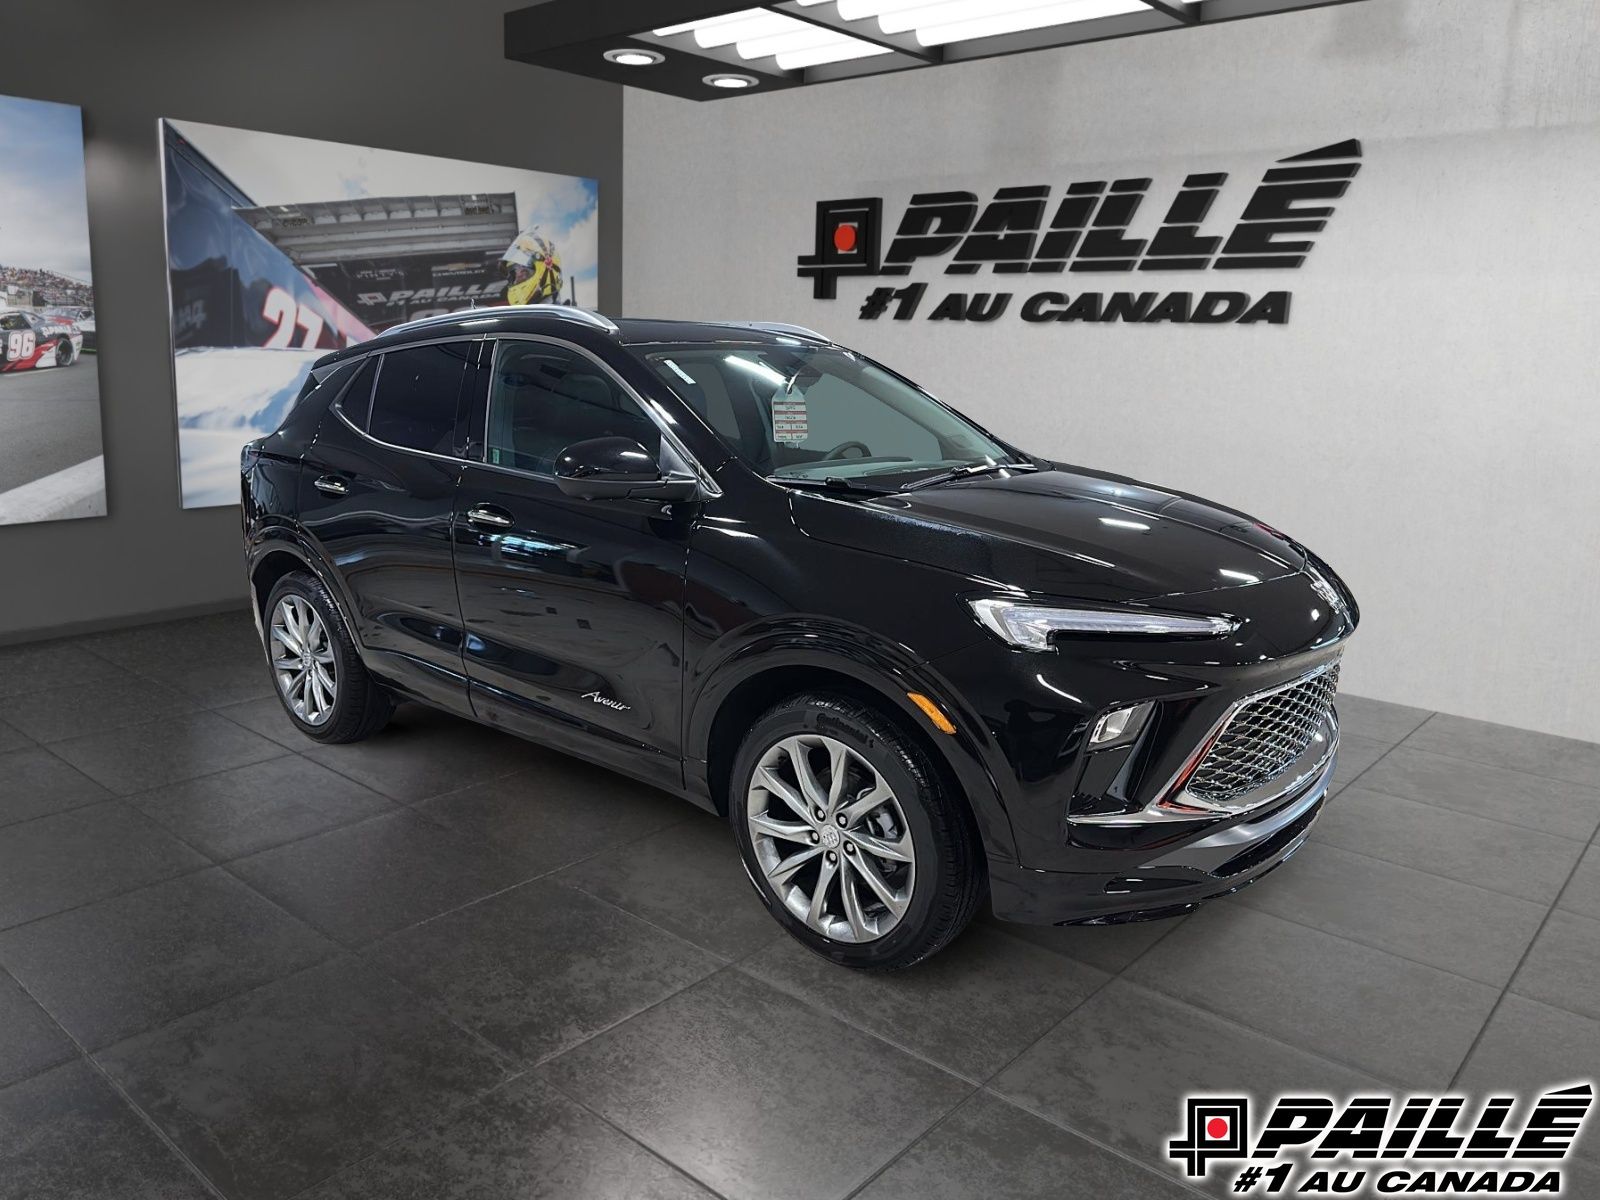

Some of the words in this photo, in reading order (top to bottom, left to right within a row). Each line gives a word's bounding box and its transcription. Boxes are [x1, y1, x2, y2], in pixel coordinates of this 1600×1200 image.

[881, 138, 1362, 276] PAILLÉ
[262, 285, 324, 349] 27
[858, 283, 928, 321] #1
[928, 292, 1013, 322] AU
[1019, 291, 1292, 324] CANADA
[7, 330, 36, 361] 96
[581, 691, 631, 711] Avenir
